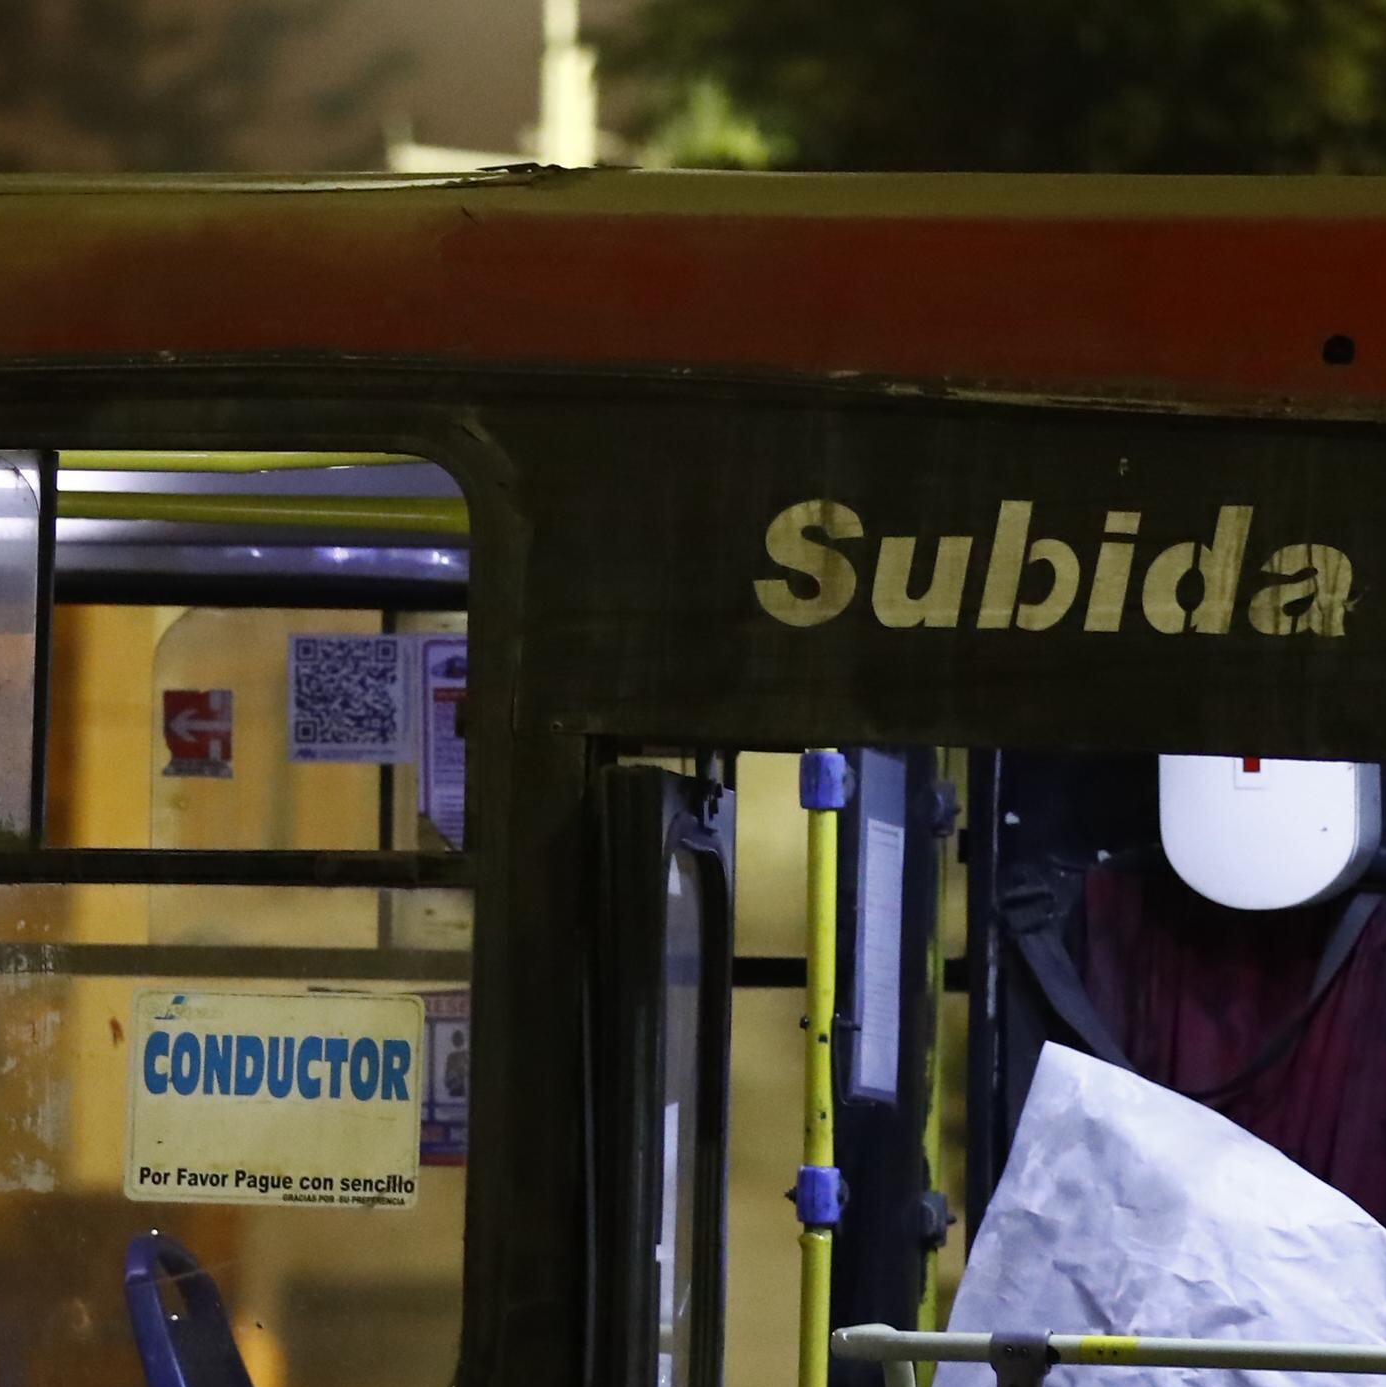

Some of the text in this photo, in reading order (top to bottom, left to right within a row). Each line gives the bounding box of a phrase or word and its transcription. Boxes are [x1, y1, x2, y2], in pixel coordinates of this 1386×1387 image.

[752, 498, 1354, 638] Subida
[144, 1031, 411, 1101] CONDUCTOR
[139, 1167, 415, 1194] Por Favor Pague con sencillo
